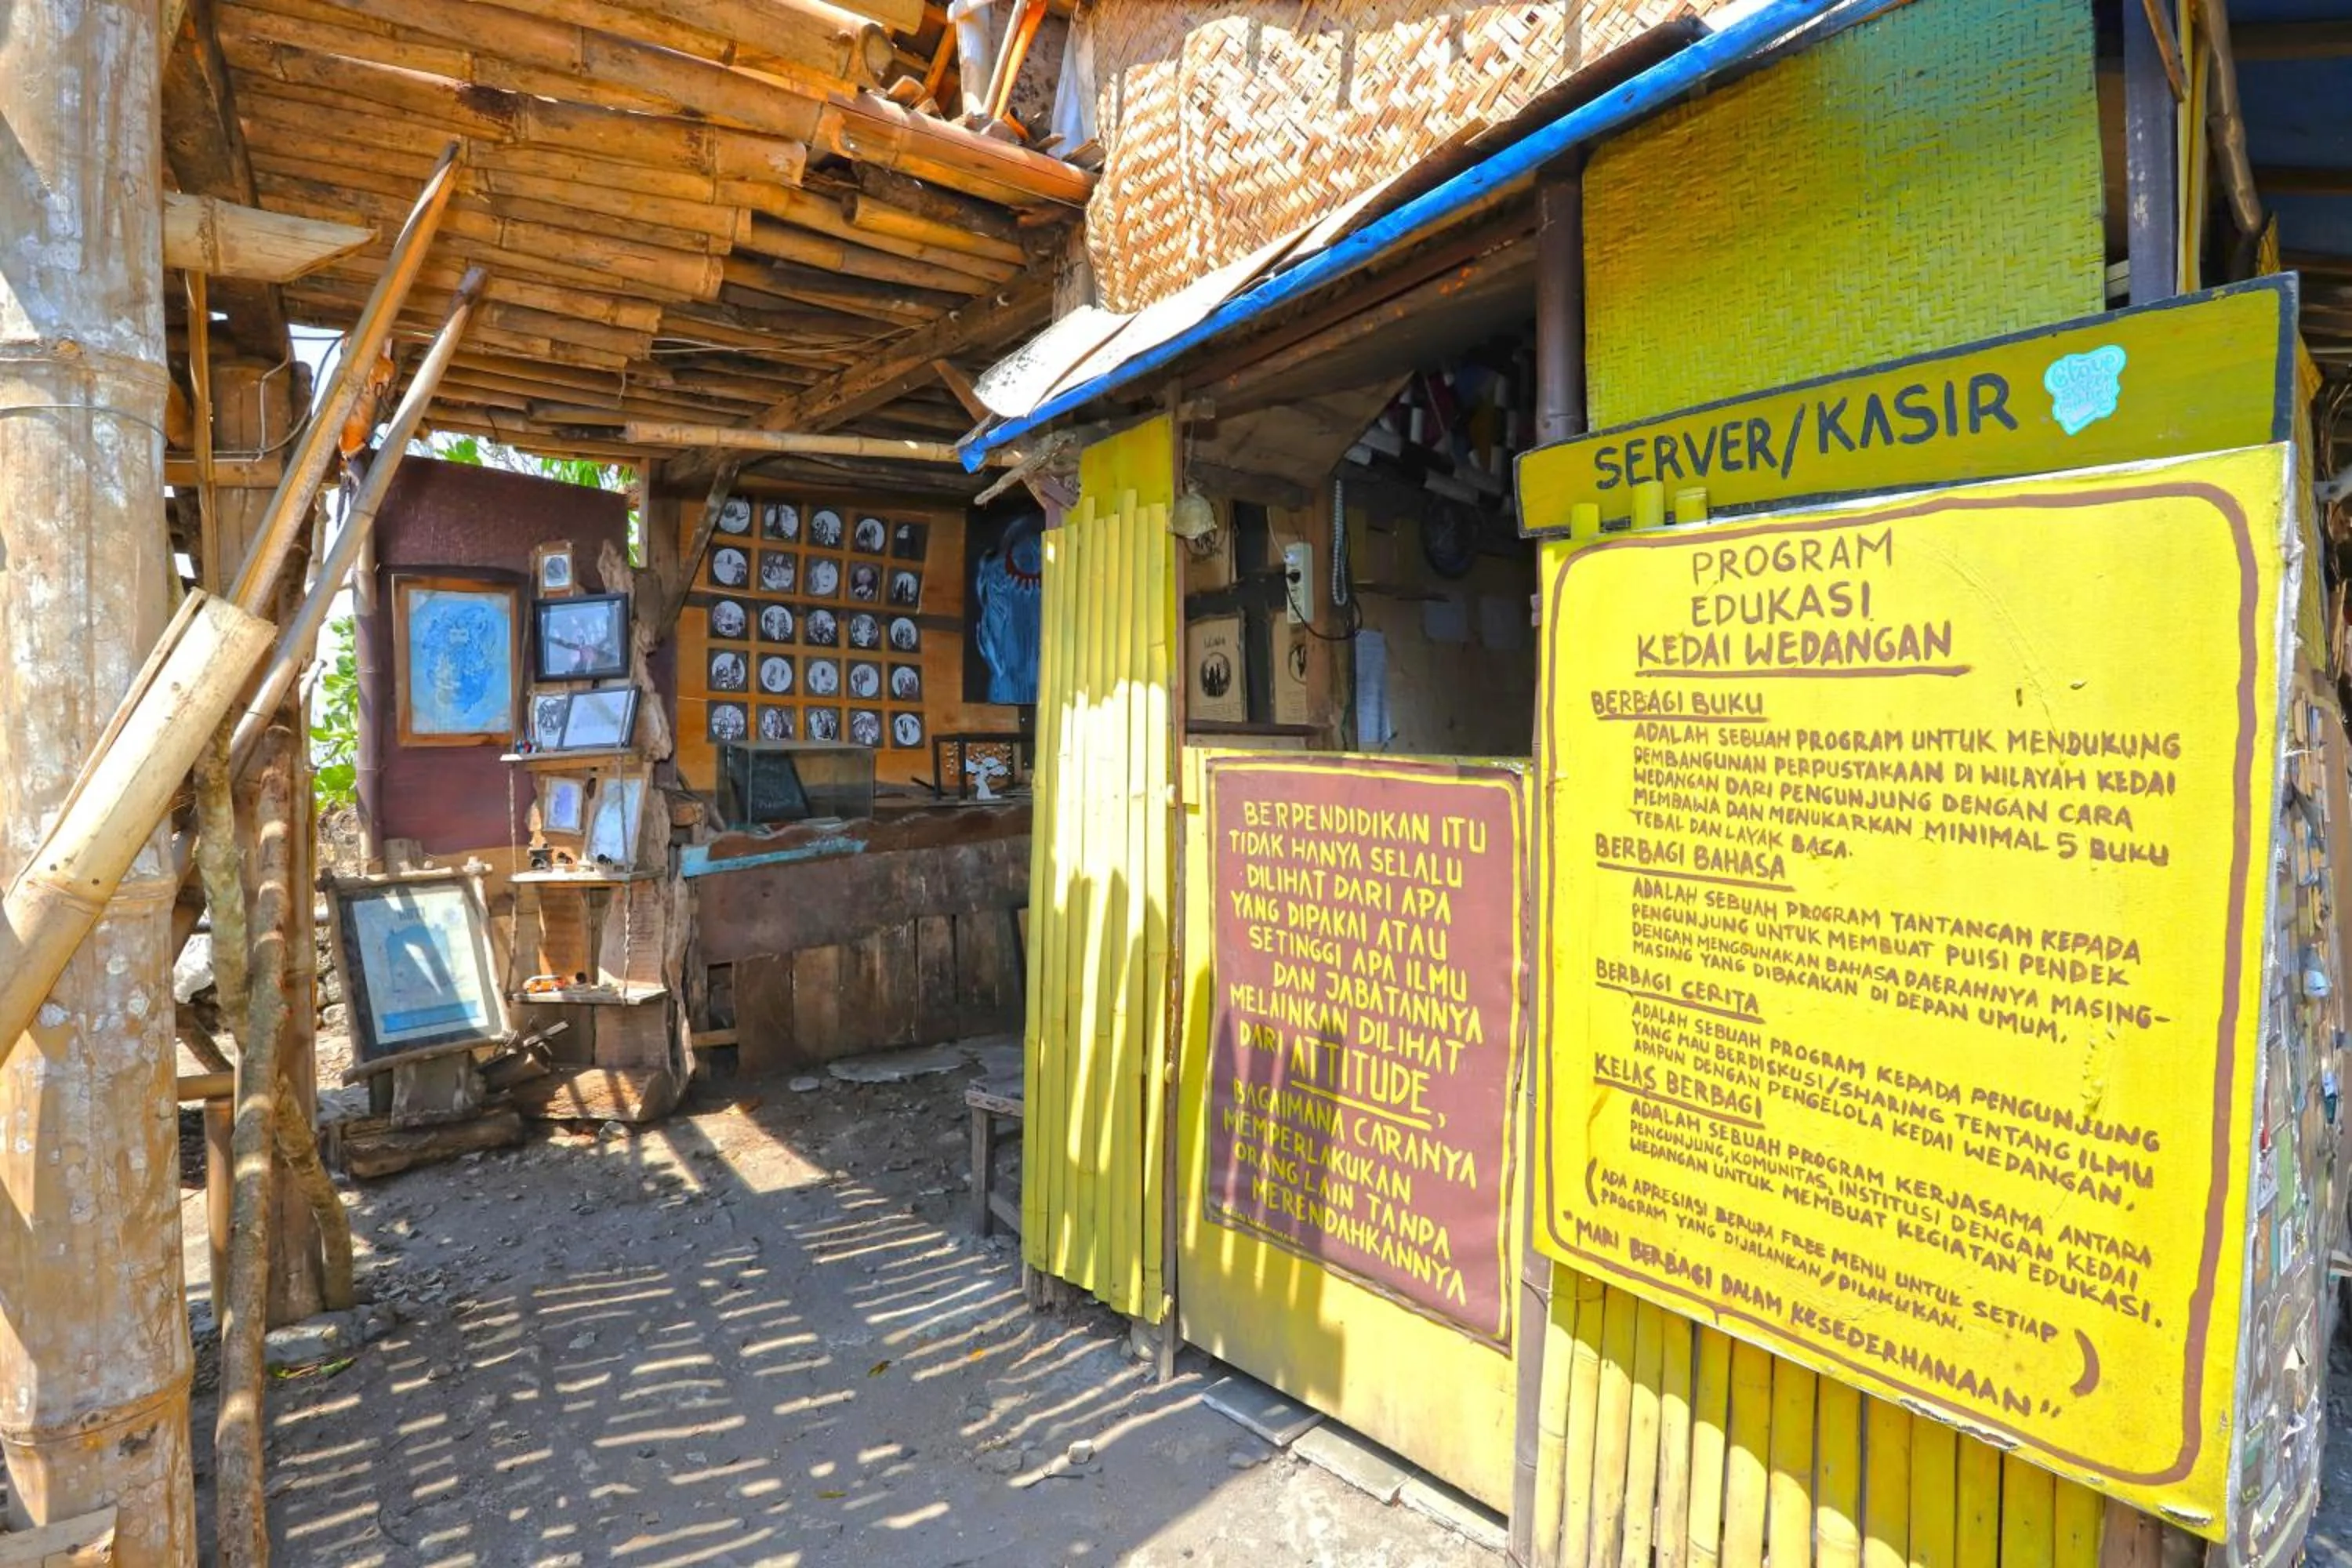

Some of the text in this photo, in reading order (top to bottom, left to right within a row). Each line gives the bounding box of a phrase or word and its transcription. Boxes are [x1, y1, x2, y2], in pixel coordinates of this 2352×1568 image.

[1693, 528, 1893, 583] PROGRAM
[1693, 583, 1870, 628] EDUKASI
[1637, 621, 1952, 670] KEDAI WEDANGAN
[1592, 689, 1762, 715] BERBAGI BUKU
[1634, 723, 2180, 760] ADALAH SEBUAH PROGRAM UNTUK MENDUKUNG
[1634, 746, 2175, 797] PEMBANGUNAN PERPUSTAKAAN DI WILAYAH KEDAI
[1244, 801, 1486, 853] BERPENDIDIKAN ITU
[1630, 808, 1684, 833] TEBAL
[1690, 818, 1722, 837] DAN
[1726, 822, 1783, 851] LAYAK
[1634, 768, 2133, 831] WEDANGAN DARI PENGUNJUNG DENGAN CARA
[1634, 787, 2168, 866] MEMBAWA DAN MENUKARKAN MINIMAL 5 BUKU
[1229, 829, 1462, 888] TIDAK HANYA SELALU
[1247, 864, 1450, 924] DILIHAT DARI APA
[1595, 833, 1785, 881] BERBAGI BAHASA
[1231, 891, 1446, 960] YANG DIPAKAI ATAU
[1632, 903, 2130, 985] PENGUNJUNG UNTUK MEMBUAT PUISI PENDEK
[1633, 877, 2140, 965] ADALAH SEBUAH PROGRAM TANTANGAN KEPADA
[1249, 926, 1465, 1002] SETINGGI APA ILMU
[1275, 961, 1483, 1044] DAN JABATANNYA
[1596, 957, 1759, 1014] BERBAGI CERITA
[1633, 922, 1692, 946] DENGAN
[1697, 935, 1819, 969] MENGGUNAKAN
[1826, 957, 1899, 986] BAHASA
[1905, 969, 2038, 1007] DAERAHNYA
[1633, 941, 1692, 963] MASING
[1700, 953, 1745, 971] YANG
[1754, 963, 1857, 996] DIBACAKAN
[1871, 985, 1888, 1004] DI
[1896, 991, 1968, 1021] DEPAN
[1230, 984, 1465, 1076] MELAINKAN DILIHAT
[1240, 1021, 1283, 1054] DARI
[1595, 1052, 1762, 1119] KELAS BERBAGI
[1632, 1000, 2160, 1152] ADALAH SEBUAH PROGRAM KEPADA PENGUNJUNG
[1632, 1020, 1671, 1043] YANG
[1678, 1033, 1709, 1053] MAU
[1955, 1112, 2070, 1160] TENTANG
[2078, 1149, 2154, 1189] ILMU
[1635, 1039, 1685, 1064] APAPUN
[1694, 1055, 1759, 1090] DENGAN
[1768, 1080, 1883, 1131] PENGELOLA
[1893, 1119, 1953, 1152] KEDAI
[1224, 1106, 1410, 1203] MEMPERLAKUKAN
[1233, 1078, 1476, 1189] BAGAIMANA CARANYA
[1632, 1098, 1700, 1133] ADALAH
[1709, 1122, 1780, 1156] SEBUAH
[1788, 1145, 1884, 1187] PROGRAM
[1896, 1176, 2043, 1236] KERJASAMA
[1235, 1142, 1450, 1260] ORANG LAIN TANPA
[1601, 1188, 1666, 1221] PROGRAM
[1676, 1215, 1715, 1239] YANG
[1630, 1138, 2162, 1328] WEDANGAN UNTUK MEMBUAT KEGIATAN EDUKASI.
[1840, 1179, 1940, 1225] INSTITUSI
[1951, 1214, 2053, 1262] DENGAN
[2067, 1251, 2138, 1292] KEDAI
[1254, 1180, 1466, 1305] MERENDAHKANNYA
[1629, 1238, 1711, 1289] BERBAGI
[1722, 1273, 1781, 1316] DALAM
[1634, 1178, 1707, 1216] APRESIASI
[1716, 1206, 1773, 1240] BERUPA
[1781, 1229, 1825, 1258] FREE
[1831, 1247, 1886, 1281] MENU
[1896, 1272, 1962, 1307] UNTUK
